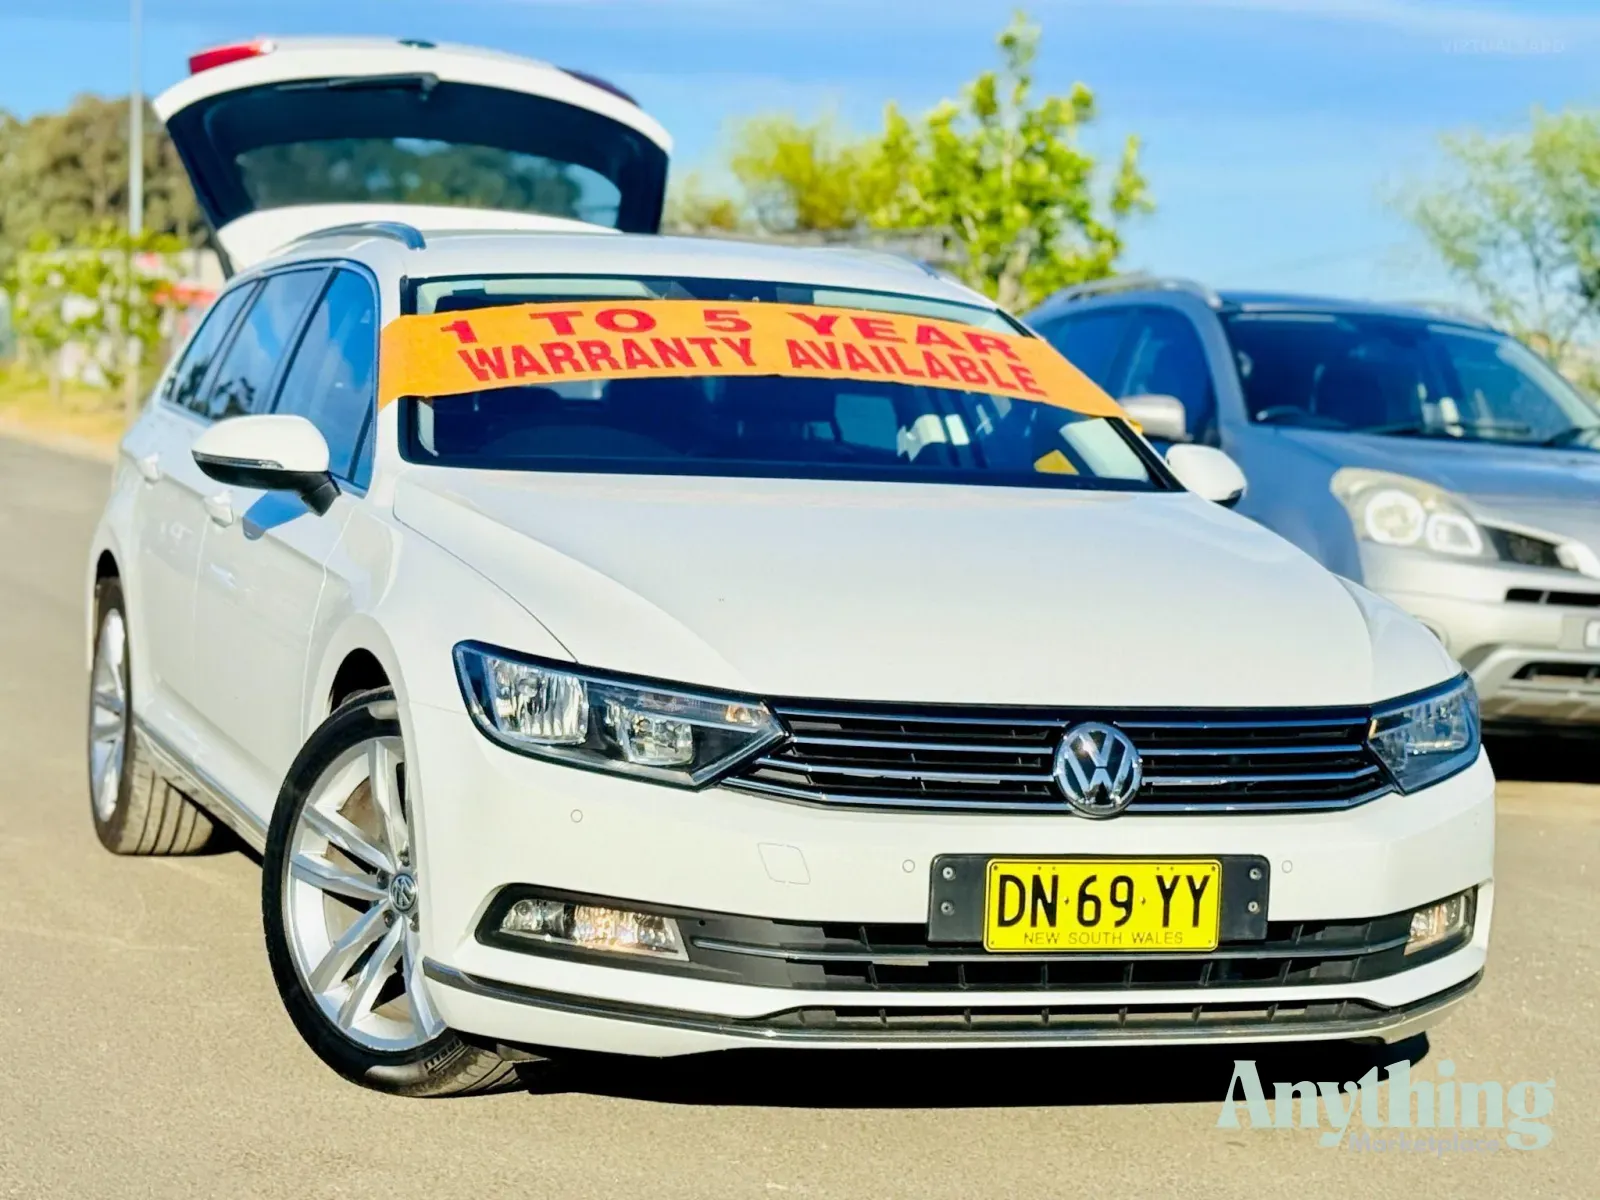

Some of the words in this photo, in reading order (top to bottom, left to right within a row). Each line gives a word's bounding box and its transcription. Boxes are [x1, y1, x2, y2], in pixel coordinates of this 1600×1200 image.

[441, 320, 477, 344] 1
[530, 308, 657, 335] TO
[703, 309, 752, 332] 5
[789, 312, 1020, 361] YEAR
[457, 337, 755, 384] WARRANTY
[786, 338, 1046, 395] AVAILABLE
[998, 874, 1059, 928] DN
[1077, 874, 1134, 928] 69
[1155, 874, 1211, 928] YY
[1023, 931, 1060, 945] NEW
[1068, 931, 1122, 945] SOUTH
[1131, 931, 1184, 945] WALES
